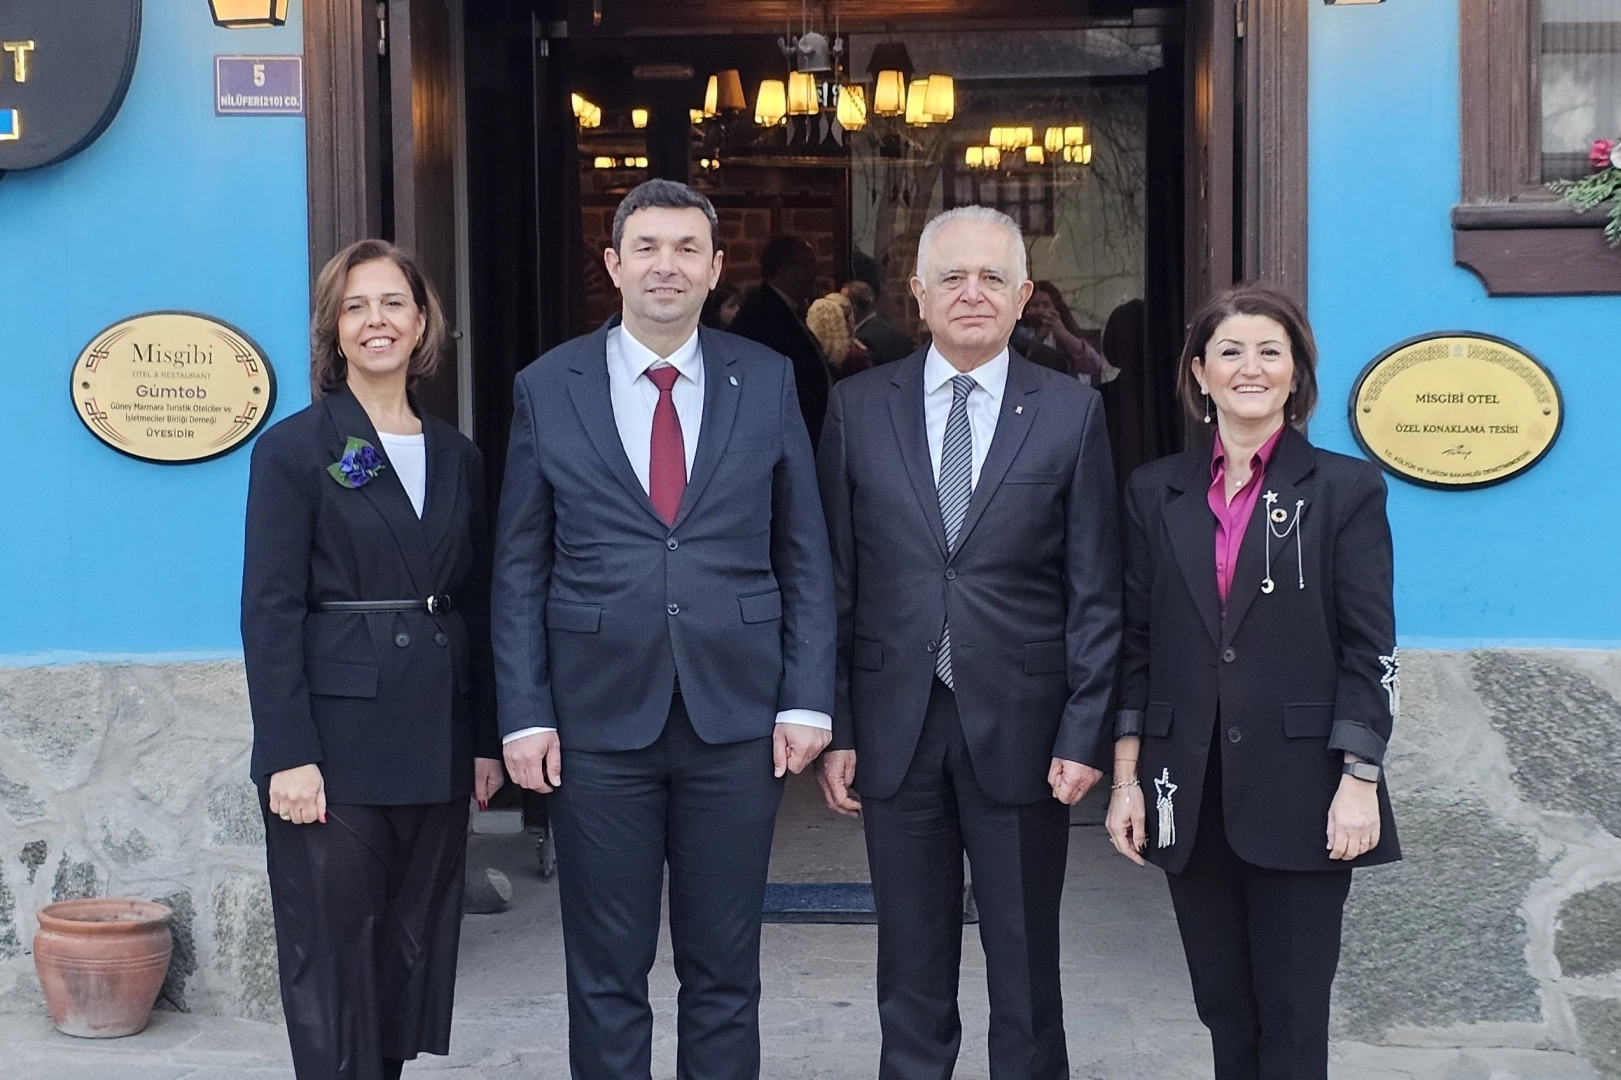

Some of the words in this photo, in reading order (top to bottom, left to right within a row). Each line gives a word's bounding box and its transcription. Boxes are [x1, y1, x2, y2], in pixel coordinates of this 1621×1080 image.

[253, 64, 265, 87] 5
[284, 96, 300, 107] CD.
[132, 343, 214, 368] Misgibi
[1415, 392, 1464, 404] MİSGİBİ
[1467, 394, 1500, 404] OTEL
[110, 402, 132, 411] Güney
[134, 403, 164, 411] Marmara
[166, 403, 191, 412] Turistik
[193, 404, 222, 412] Otelciler
[125, 413, 165, 422] İşletmeciler
[167, 415, 188, 424] Birliği
[189, 415, 217, 424] Derneği
[146, 427, 195, 438] ÜYESİDİR
[1395, 422, 1420, 433] ÖZEL
[1423, 424, 1486, 434] KONAKLAMA
[1488, 424, 1519, 434] TESİSİ
[1394, 456, 1416, 470] KÜLTÜR
